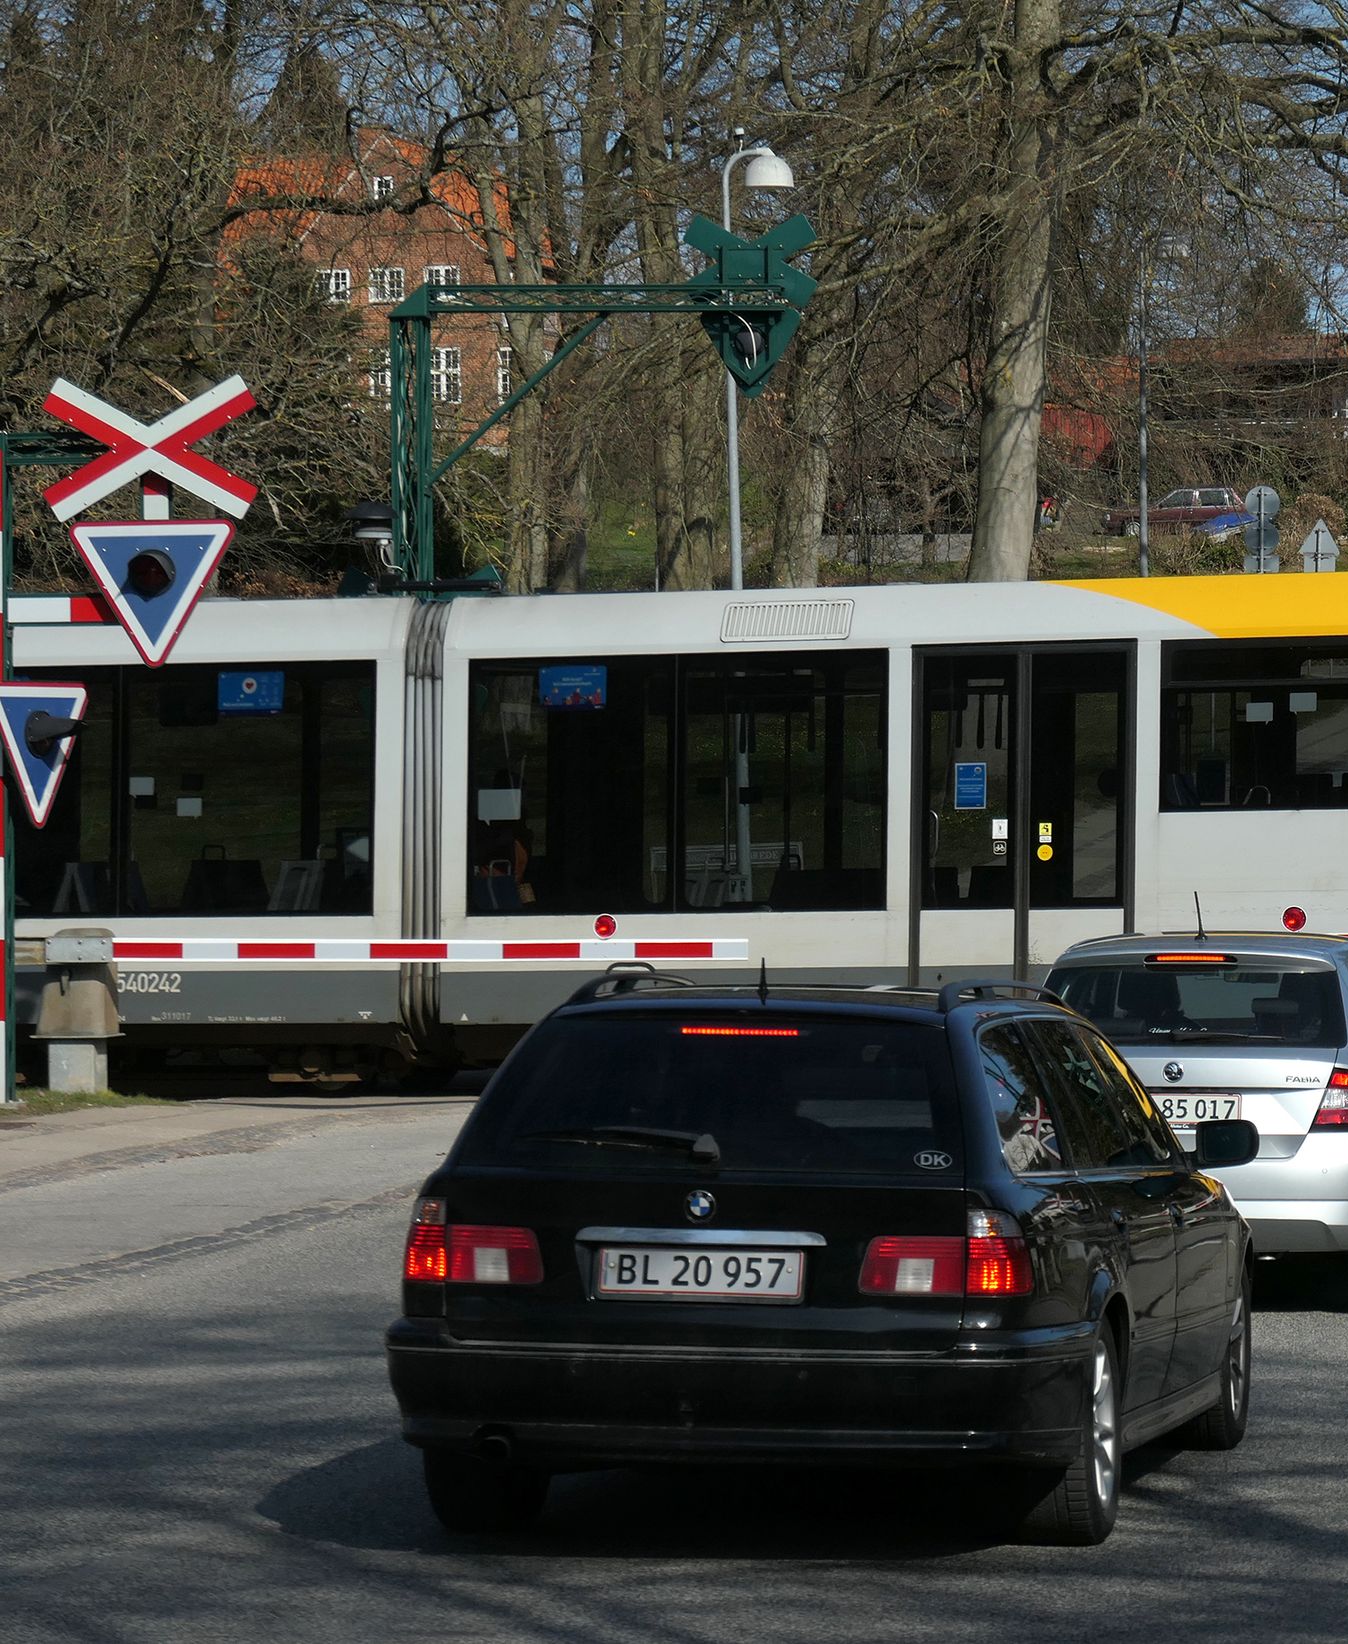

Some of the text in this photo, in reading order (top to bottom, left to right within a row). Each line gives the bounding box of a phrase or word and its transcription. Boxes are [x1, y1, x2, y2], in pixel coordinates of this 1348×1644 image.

[117, 973, 181, 993] 540242
[1285, 1075, 1321, 1084] FABIA
[1161, 1099, 1236, 1120] 85 017
[920, 1154, 947, 1166] DK
[616, 1254, 786, 1288] BL 20 957
